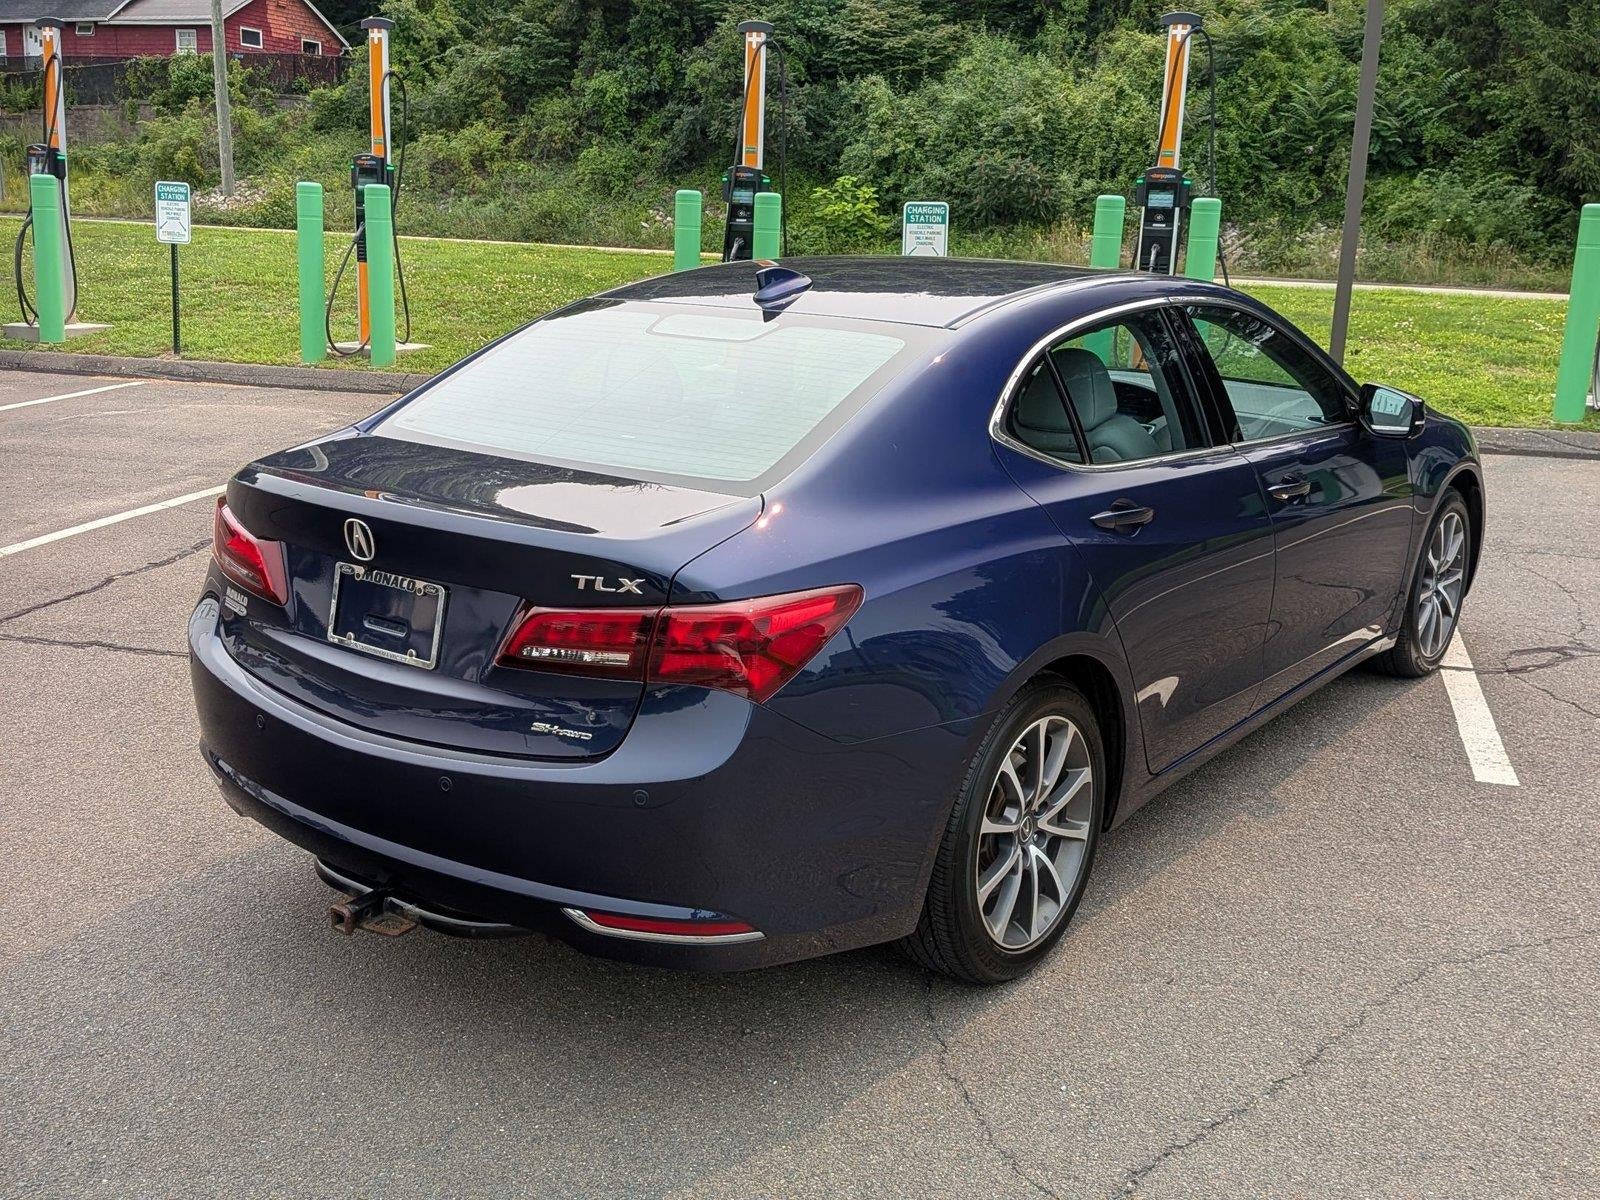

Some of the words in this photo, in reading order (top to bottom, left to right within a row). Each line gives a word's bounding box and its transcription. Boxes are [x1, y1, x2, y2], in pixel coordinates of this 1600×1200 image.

[158, 185, 187, 193] CHARGING
[907, 206, 945, 214] CHARGING
[910, 214, 942, 223] STATION
[362, 569, 416, 592] MONACO
[571, 574, 646, 595] TLX
